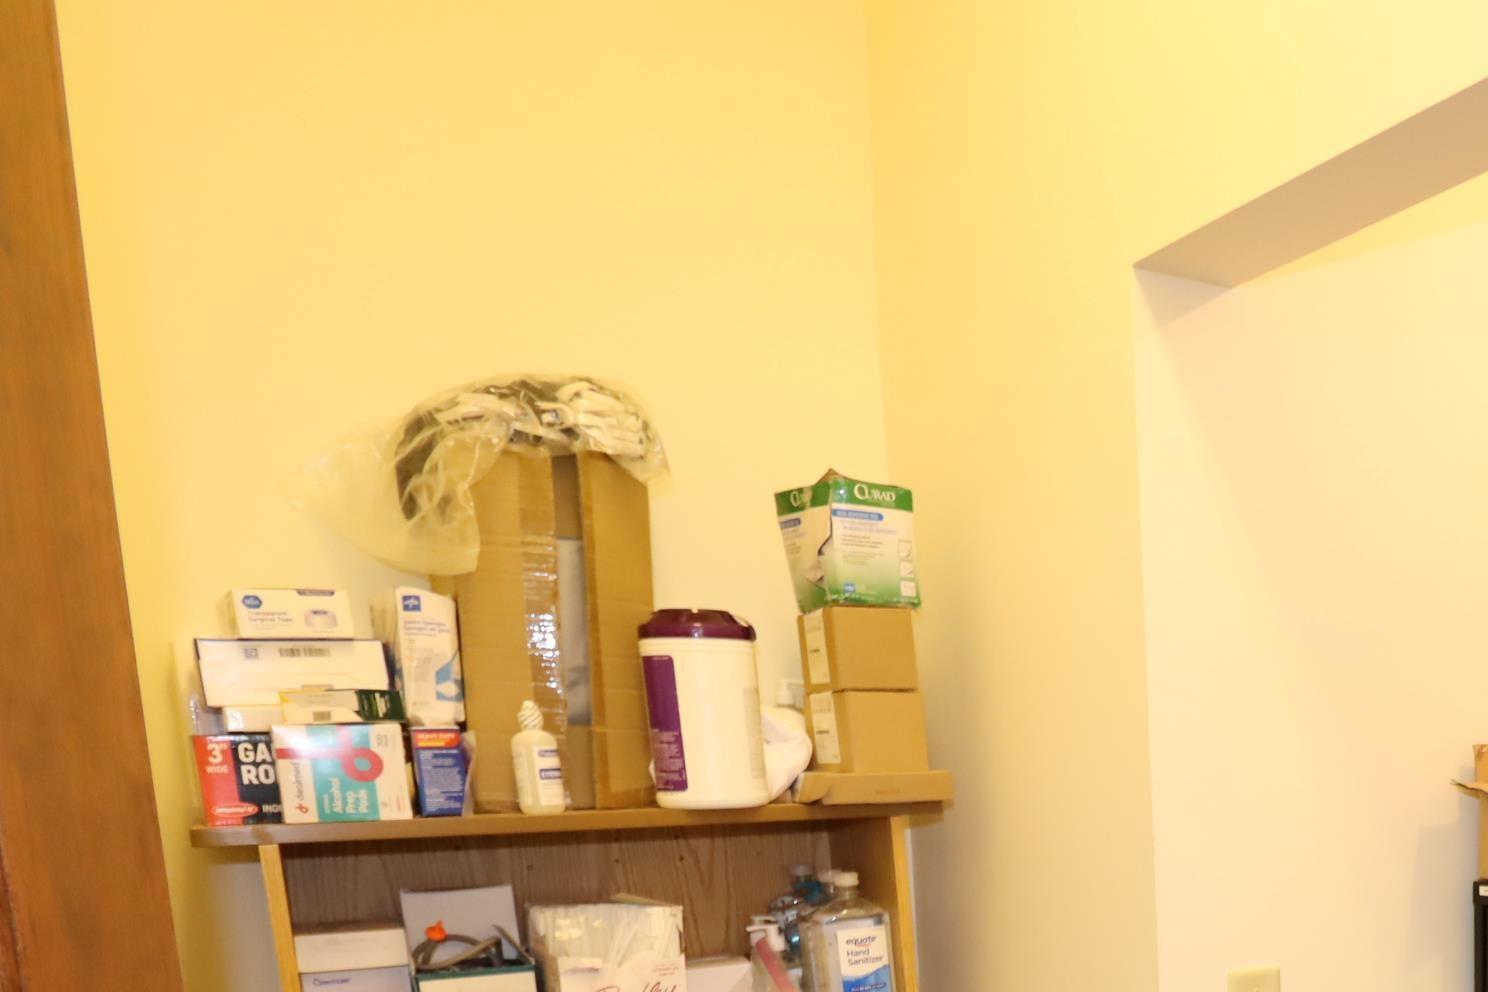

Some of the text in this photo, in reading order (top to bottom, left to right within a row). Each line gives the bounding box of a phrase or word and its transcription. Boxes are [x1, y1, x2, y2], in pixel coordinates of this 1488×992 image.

[854, 483, 896, 502] CURAD
[237, 742, 272, 763] GA
[240, 764, 276, 785] RO
[845, 935, 878, 947] equate
[847, 949, 870, 959] Hand
[847, 956, 883, 966] Sanitizer
